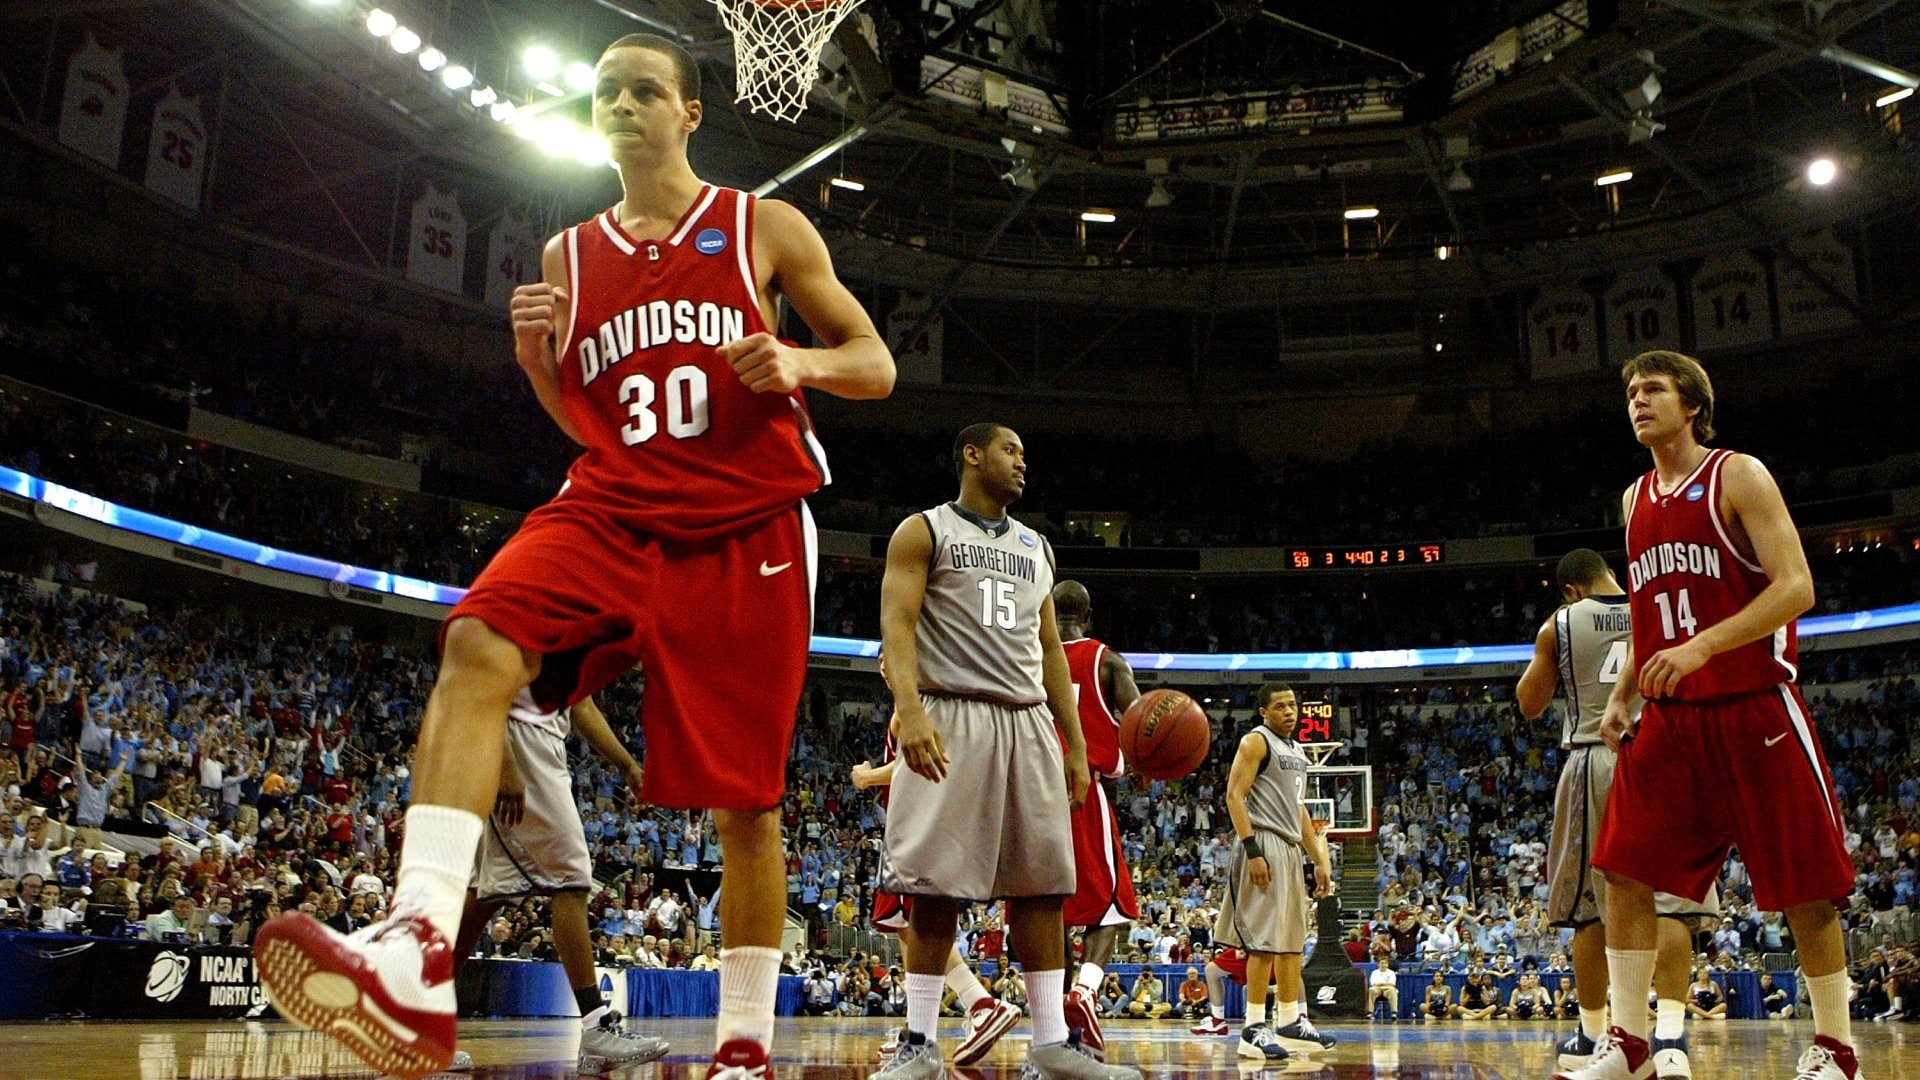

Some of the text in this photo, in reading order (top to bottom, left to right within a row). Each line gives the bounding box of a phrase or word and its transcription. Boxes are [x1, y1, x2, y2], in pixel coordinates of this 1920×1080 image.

[162, 130, 193, 169] 25
[423, 225, 453, 259] 35
[1624, 307, 1660, 345] 10
[1712, 291, 1750, 329] 14
[579, 299, 744, 387] DAVIDSON
[1546, 322, 1580, 357] 14
[618, 364, 710, 447] 30
[950, 543, 1036, 584] GEORGETOWN
[1294, 550, 1440, 567] 58 3 4:40 2 3 57
[1629, 541, 1722, 594] DAVIDSON
[977, 576, 1017, 630] 15
[1592, 612, 1632, 632] WRIGH
[1654, 588, 1698, 641] 14
[1598, 640, 1629, 684] 4
[1299, 718, 1330, 742] 24
[1302, 704, 1332, 718] 4:40
[209, 985, 271, 1006] NORTH CA
